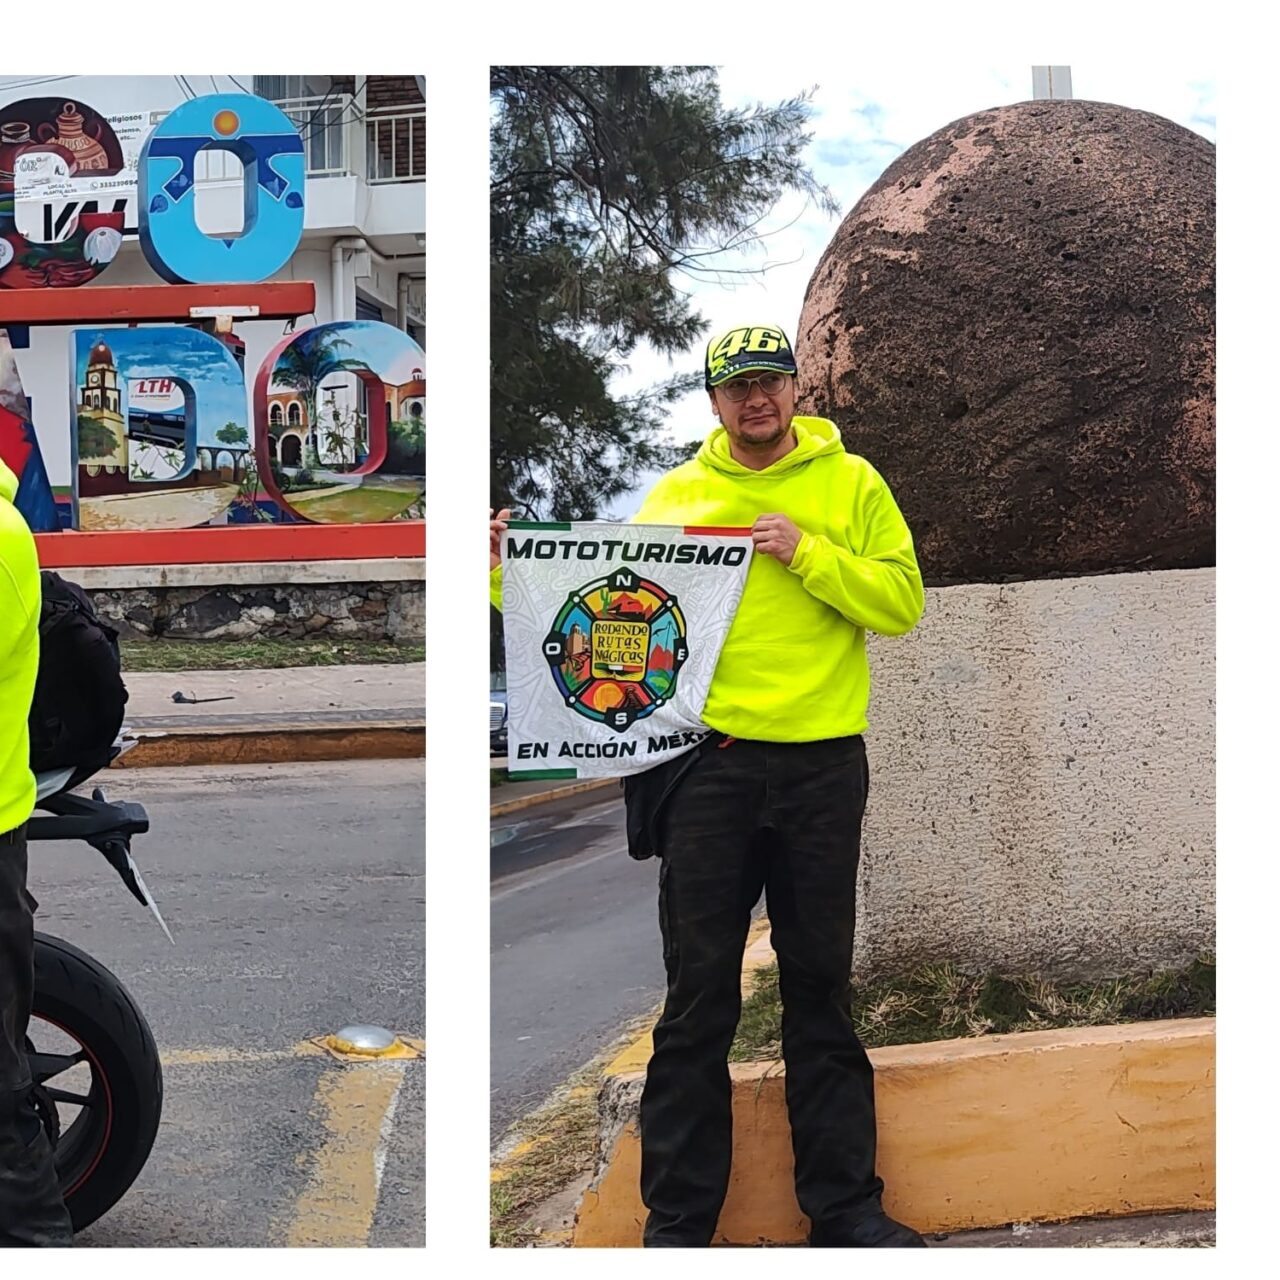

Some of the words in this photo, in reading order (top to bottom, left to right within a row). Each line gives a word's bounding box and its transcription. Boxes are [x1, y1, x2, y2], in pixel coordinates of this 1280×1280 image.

[104, 114, 142, 123] eligiosos
[712, 327, 782, 362] 46
[138, 379, 172, 393] LTH
[506, 537, 747, 567] MOTOTURISMO
[616, 574, 632, 587] N
[677, 648, 686, 661] E
[615, 712, 627, 725] S
[517, 741, 549, 760] EN
[558, 736, 637, 759] ACCIÓN
